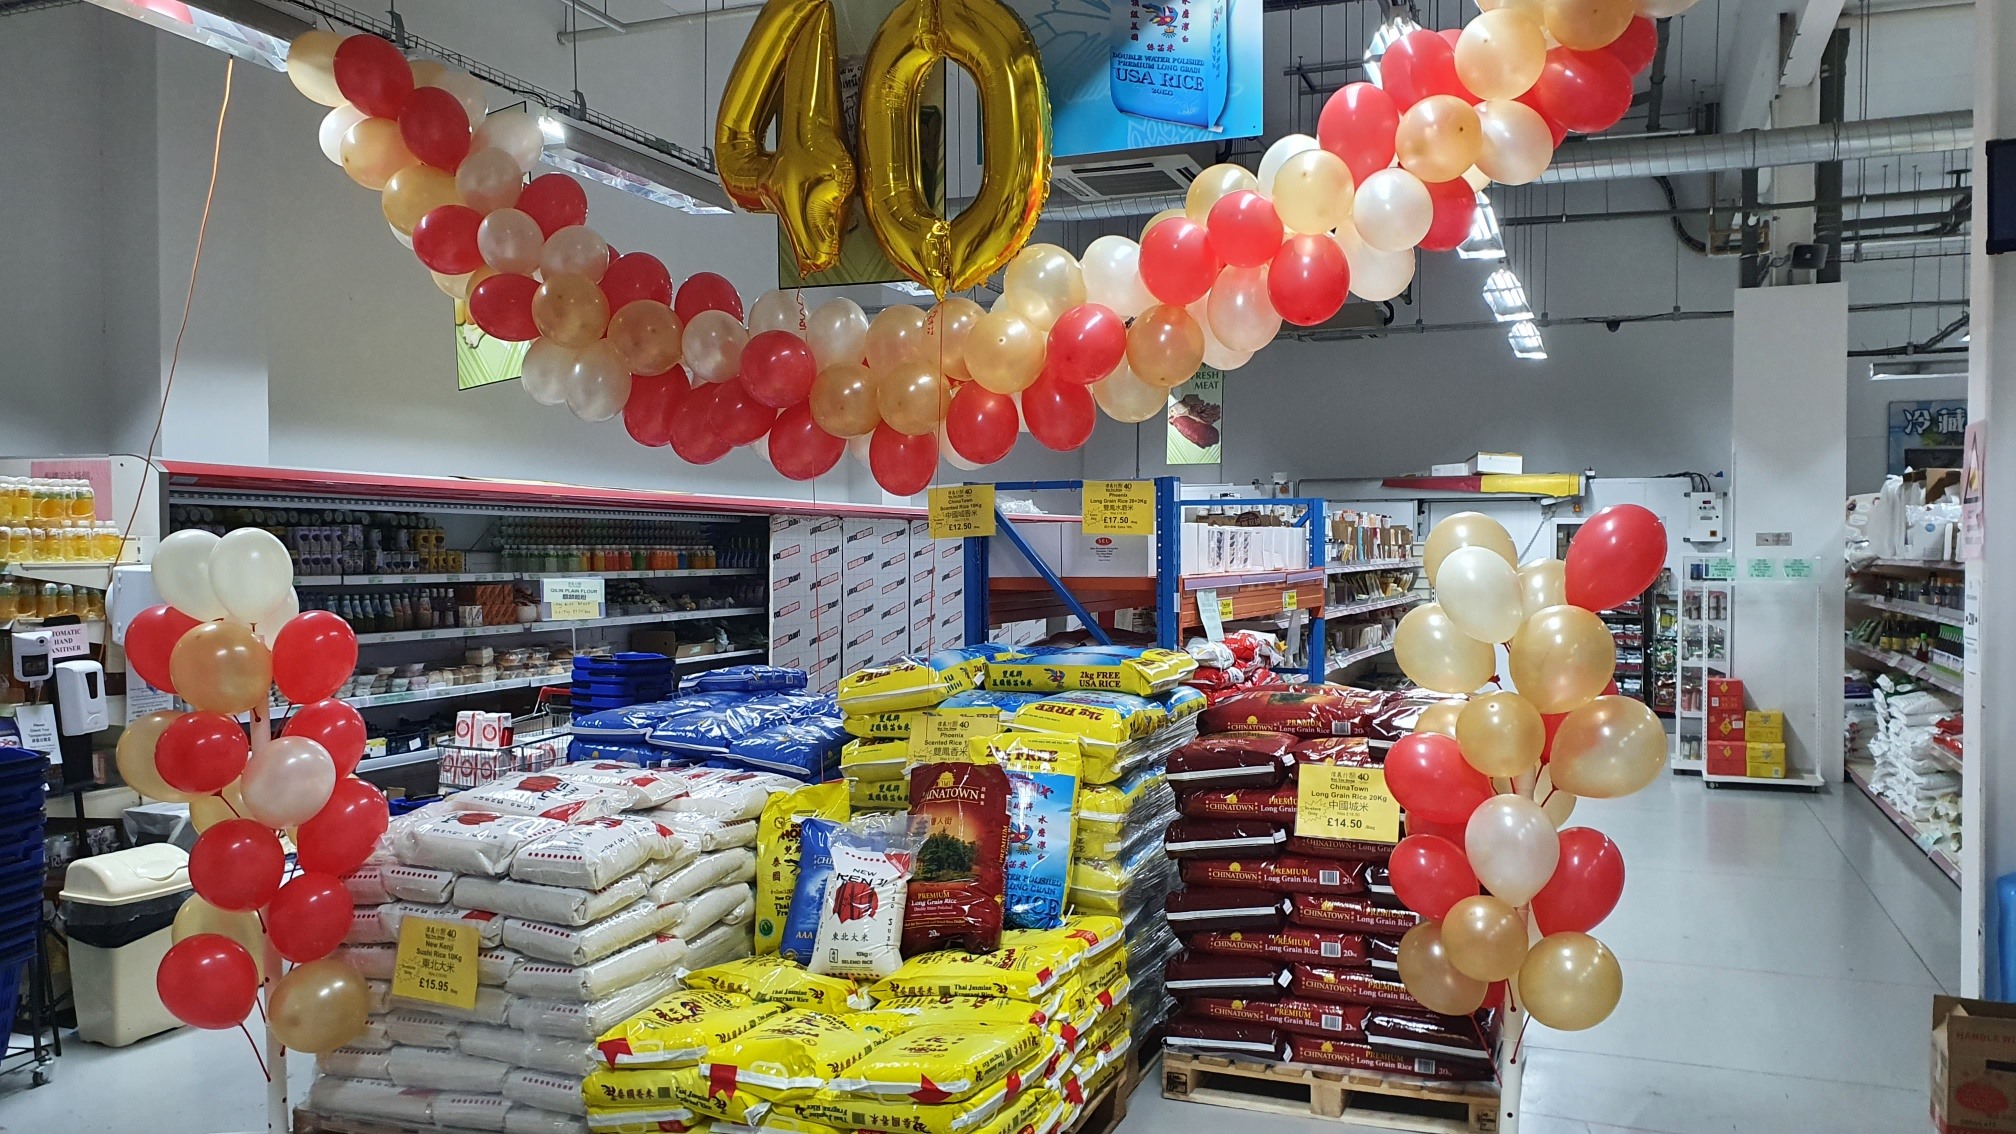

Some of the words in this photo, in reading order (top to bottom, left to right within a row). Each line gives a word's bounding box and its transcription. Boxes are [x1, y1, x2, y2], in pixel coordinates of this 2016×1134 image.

[1112, 52, 1143, 60] DOUBLE
[1145, 55, 1171, 63] WATER
[1172, 58, 1204, 66] POLISHED
[1118, 60, 1154, 69] PREMIUM
[1180, 66, 1201, 74] GRAIN
[1116, 68, 1155, 85] USA
[1160, 73, 1204, 91] RICE
[715, 0, 1053, 302] 40
[1194, 371, 1219, 380] RESH
[1194, 381, 1219, 390] MEAT
[1903, 407, 1967, 435] 冷藏
[54, 638, 73, 646] HAND
[1079, 671, 1094, 681] 2kg
[1096, 671, 1121, 680] FREE
[1079, 680, 1097, 688] USA
[1098, 680, 1121, 688] RICE
[1035, 703, 1075, 716] FREE
[1078, 709, 1105, 721] 2kg
[1286, 719, 1322, 727] PREMIUM
[1279, 725, 1296, 734] Long
[1358, 773, 1369, 781] 40
[1330, 784, 1368, 792] ChinaTown
[1209, 803, 1254, 812] CHINATOWN
[1260, 805, 1277, 813] Long
[1329, 800, 1369, 812] 中國城米
[1327, 818, 1362, 828] £14.50
[999, 825, 1008, 863] PREMIUM
[1306, 838, 1351, 849] CHINATOWN
[1359, 844, 1376, 852] Long
[852, 868, 878, 876] NEW
[1213, 870, 1258, 880] CHINATOWN
[1264, 875, 1281, 884] Long
[1302, 876, 1318, 884] Rice
[1273, 868, 1309, 876] PREMIUM
[836, 872, 888, 887] KENJI
[1023, 874, 1062, 887] POLISHED
[918, 891, 950, 899] PREMIUM
[1030, 884, 1056, 895] GRAIN
[1303, 909, 1350, 921] CHINATOWN
[1356, 916, 1375, 924] Long
[1377, 918, 1396, 926] Grain
[447, 929, 456, 939] 40
[795, 931, 813, 939] AAA
[831, 932, 869, 942] 東北大米
[439, 942, 454, 952] Kenji
[1273, 935, 1311, 947] PREMIUM
[1213, 940, 1259, 950] CHINATOWN
[1264, 944, 1282, 953] Long
[1283, 945, 1302, 954] Grain
[1303, 947, 1319, 955] Rice
[416, 948, 432, 956] Sushi
[433, 951, 447, 959] Rice
[448, 953, 463, 962] 10Kg
[422, 958, 455, 973] 東北大米
[419, 977, 449, 992] £15.95
[784, 988, 807, 996] Jasmine
[1305, 980, 1352, 993] CHINATOWN
[1358, 987, 1377, 998] Long
[1378, 990, 1398, 1000] Grain
[1400, 993, 1415, 1002] Rice
[1213, 1007, 1260, 1019] CHINATOWN
[1266, 1014, 1284, 1025] Long
[1284, 1016, 1304, 1026] Grain
[1304, 1018, 1320, 1027] Rice
[1274, 1007, 1312, 1018] PREMIUM
[1303, 1051, 1350, 1063] CHINATOWN
[1356, 1057, 1374, 1067] Long
[1375, 1060, 1396, 1070] Grain
[1397, 1063, 1413, 1071] Rice
[1365, 1050, 1404, 1062] PREMIUM
[834, 1115, 849, 1123] Thai
